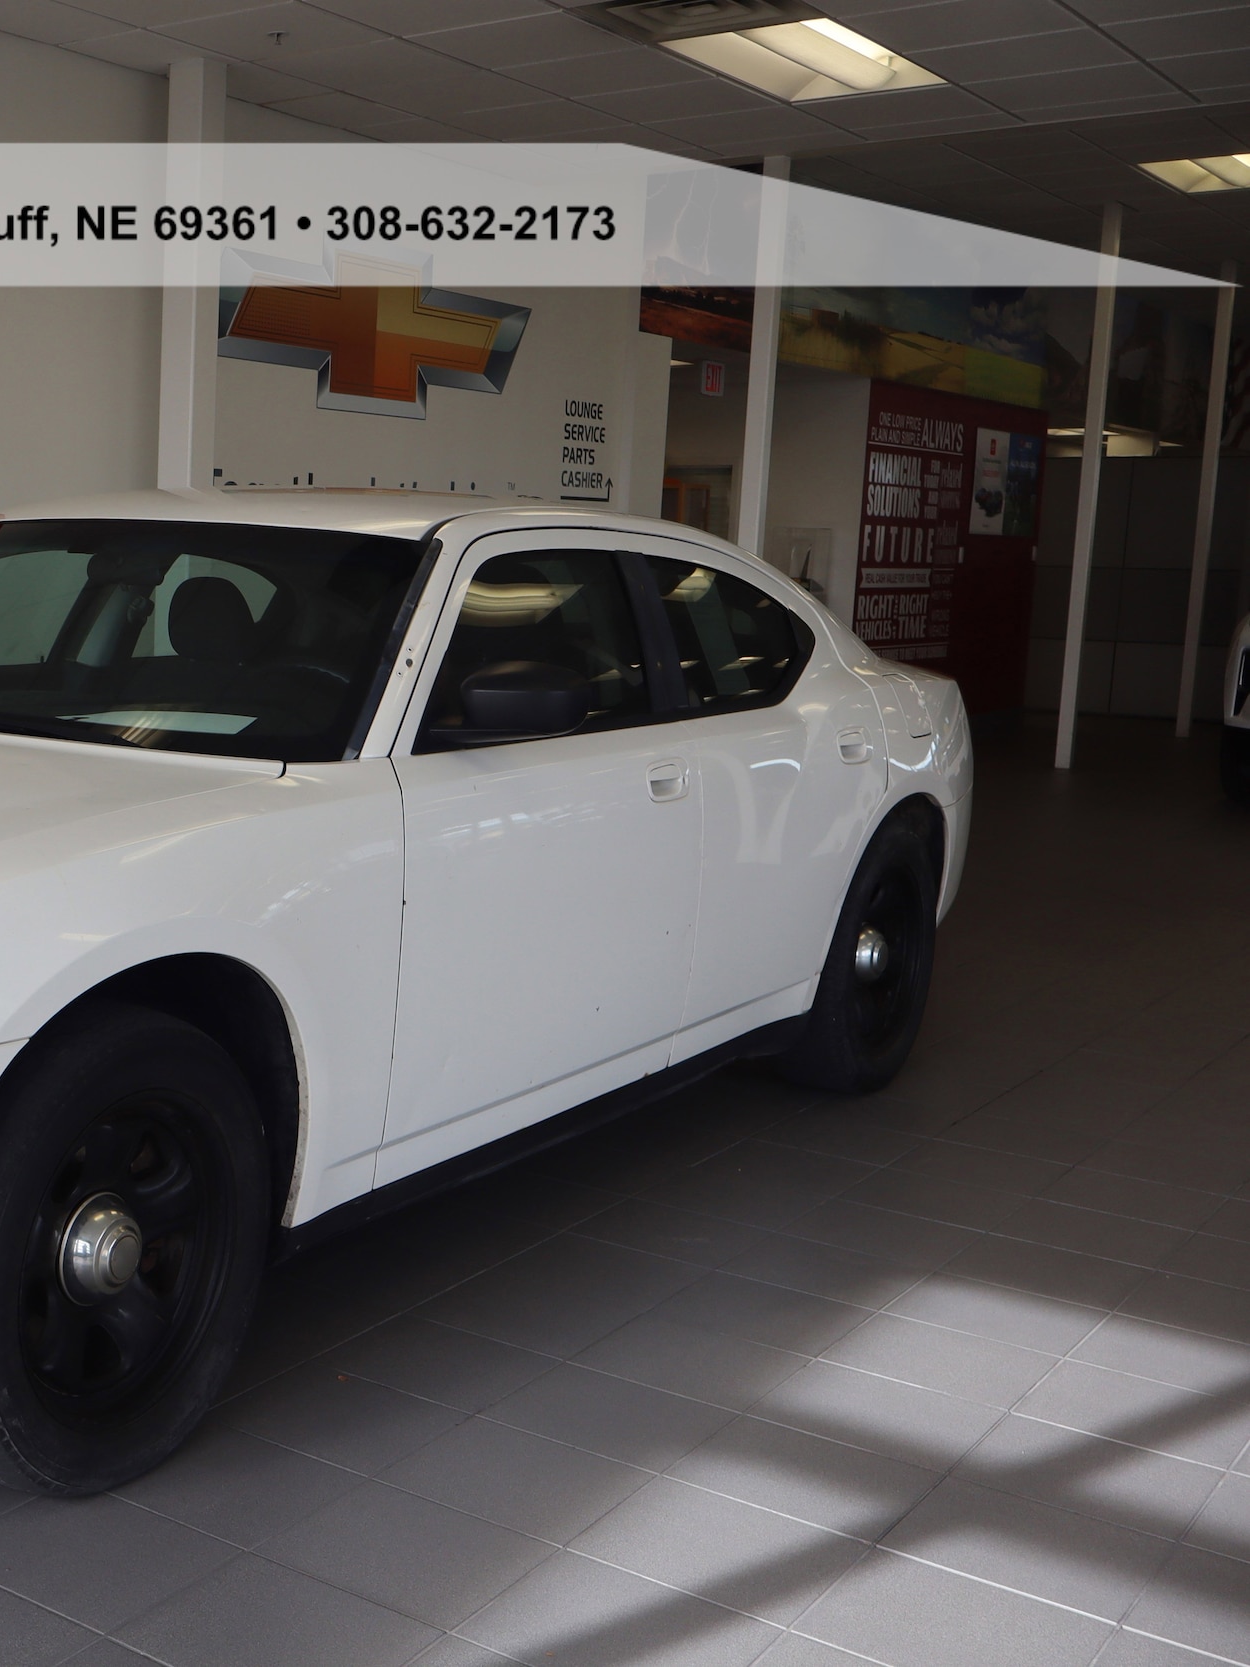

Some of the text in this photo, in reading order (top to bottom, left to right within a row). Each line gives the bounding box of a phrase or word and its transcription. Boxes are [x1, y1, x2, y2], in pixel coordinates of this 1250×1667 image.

[705, 362, 722, 393] EXIT
[565, 399, 604, 420] LOUNGE
[878, 411, 922, 431] ONE LOW PRICE
[564, 423, 606, 443] SERVICE
[871, 427, 921, 447] PLAIN AND SIMPLE
[921, 418, 964, 452] ALWAYS
[562, 446, 595, 465] PARTS
[561, 470, 603, 489] CASHIER
[868, 451, 922, 487] FINANCIAL
[866, 484, 921, 519] SOLUTIONS
[862, 524, 935, 563] FUTURE
[857, 595, 894, 620] RIGHT
[899, 593, 929, 615] RIGHT
[855, 620, 893, 641] VEHICLES
[897, 615, 928, 640] TIME
